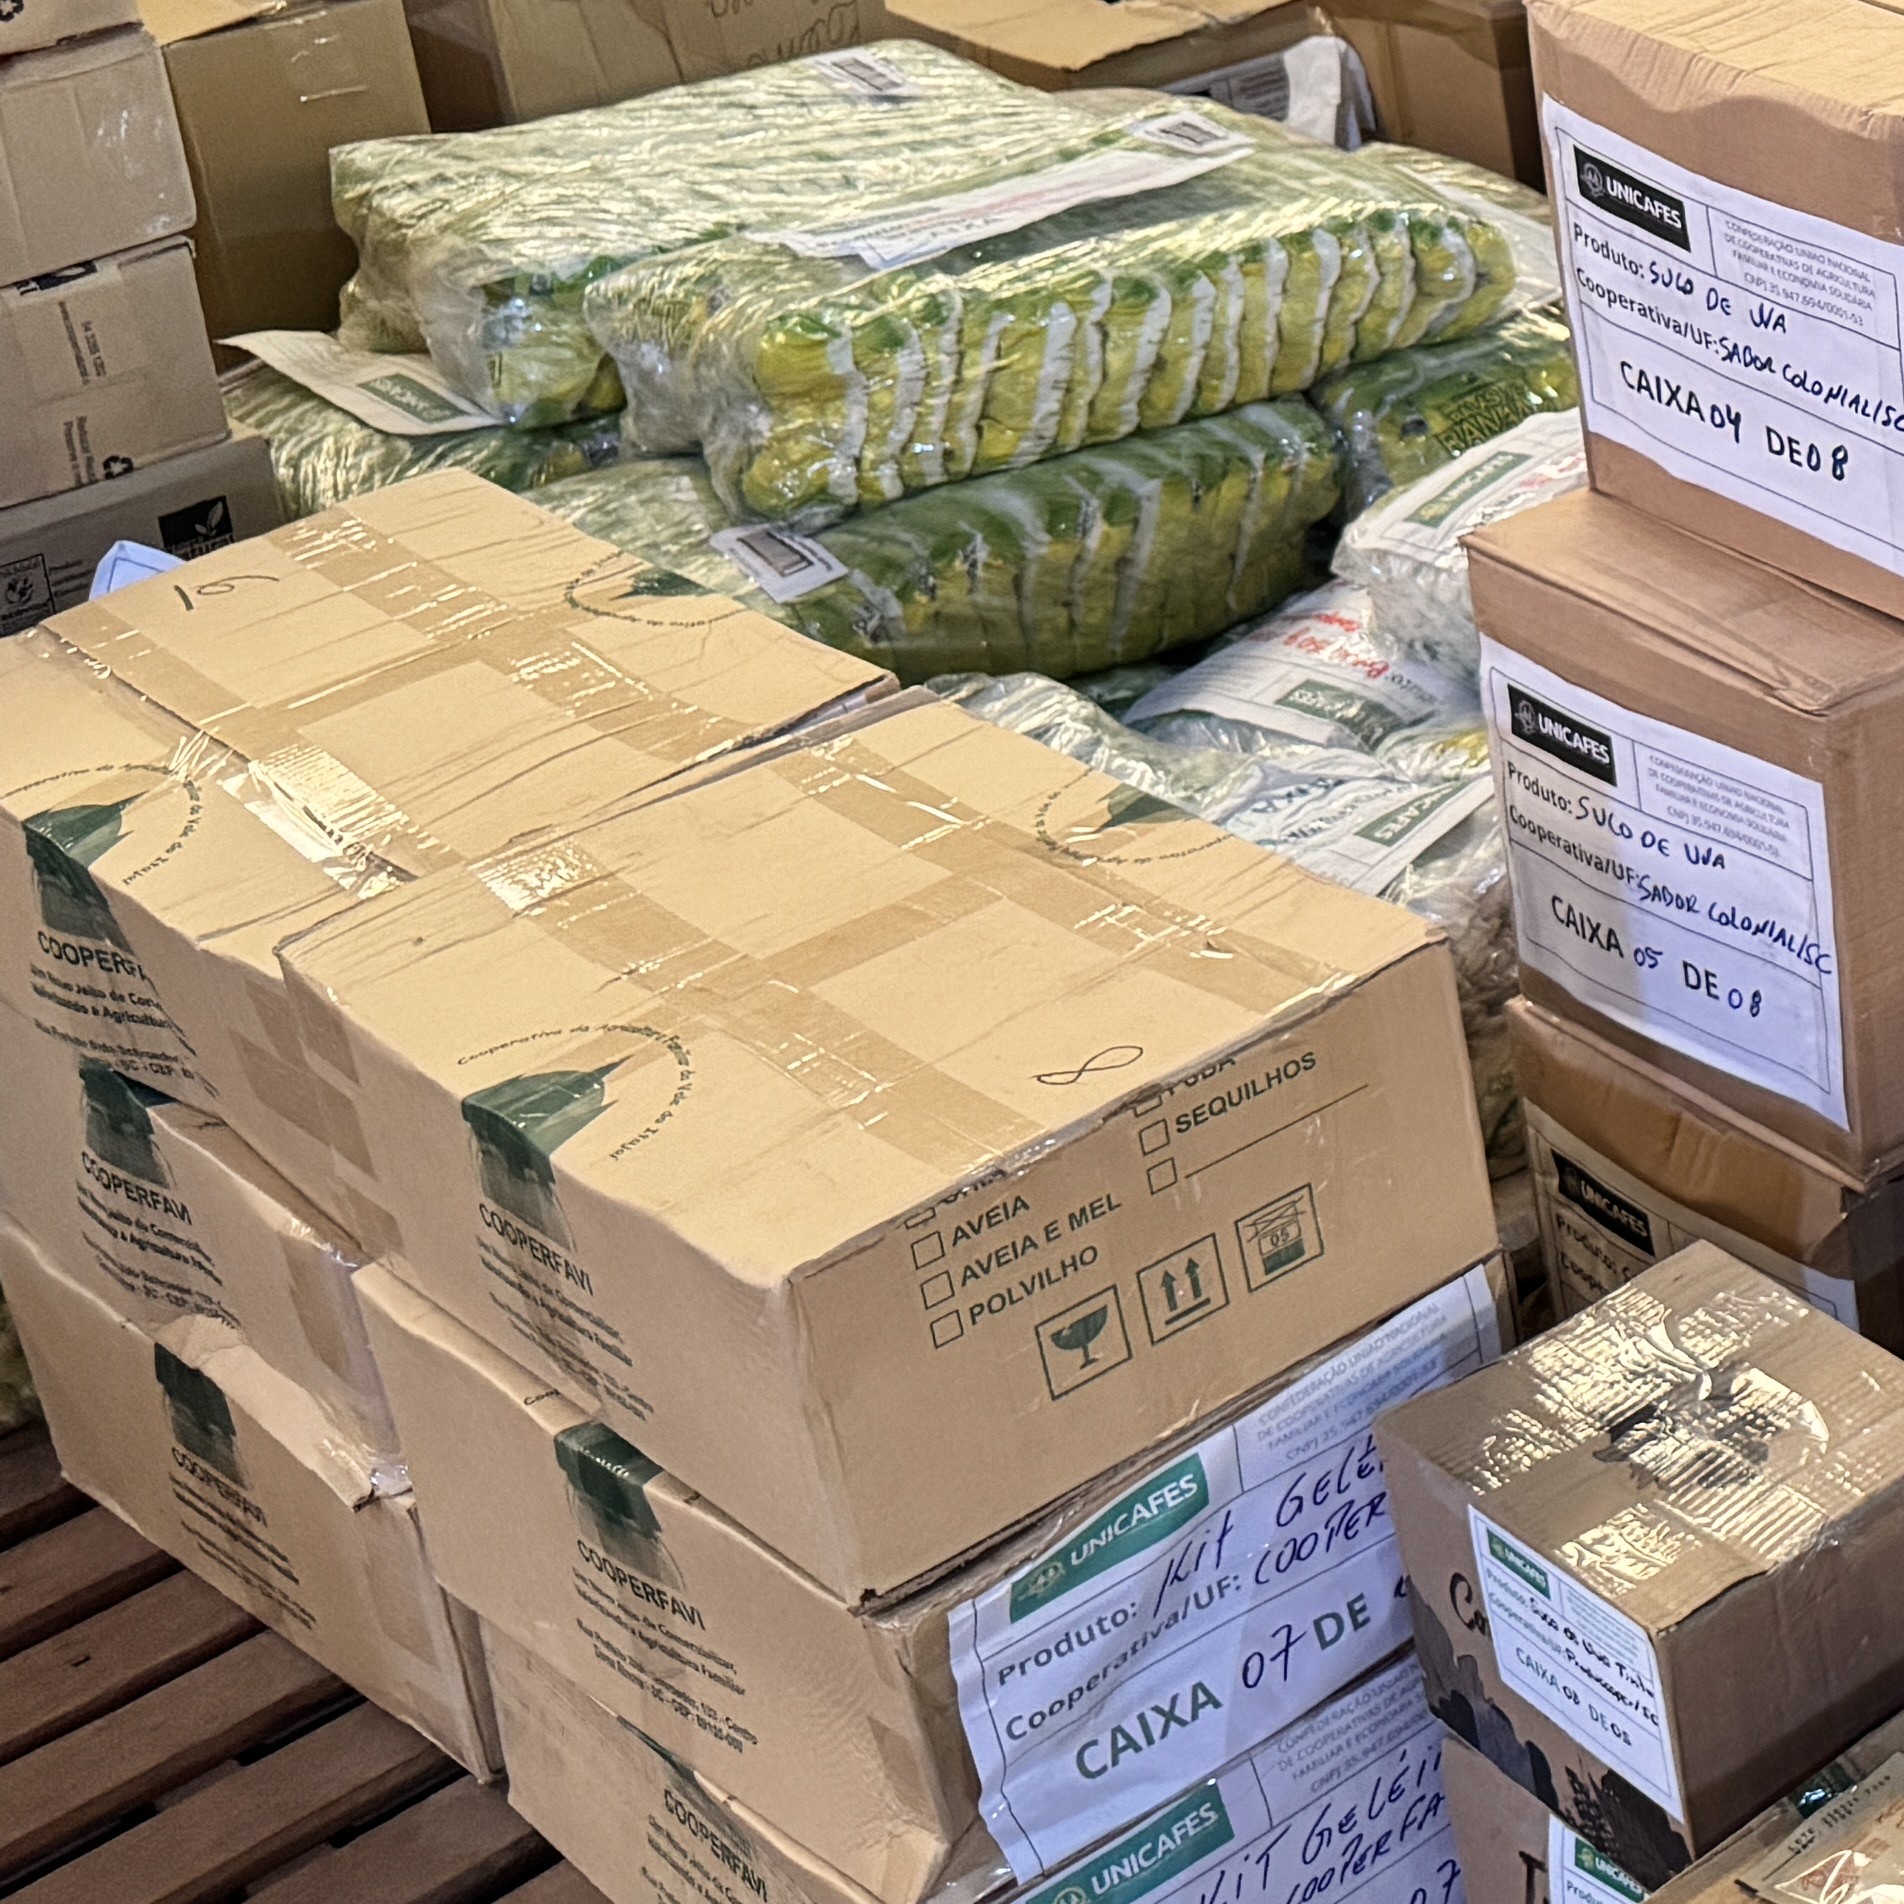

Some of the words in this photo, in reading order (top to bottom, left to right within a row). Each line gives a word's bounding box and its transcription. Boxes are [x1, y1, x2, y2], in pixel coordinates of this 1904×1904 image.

[1606, 174, 1683, 229] UNICAFES
[1573, 223, 1646, 280] Produto:
[1575, 269, 1719, 356] Cooperativa/UF:
[1619, 360, 1706, 424] CAIXA
[1708, 403, 1742, 444] 04
[1766, 425, 1802, 466] DE
[1537, 713, 1611, 766] UNICAFES
[1507, 761, 1573, 817] Produto:
[1508, 803, 1638, 888] Cooperativa/UF:
[1551, 894, 1625, 960] CAIXA
[1633, 946, 1664, 971] 05
[1681, 959, 1720, 1002] DE
[1175, 1050, 1318, 1137] SEQUILHOS
[81, 1150, 193, 1227] COOPERFAVI
[951, 1194, 1031, 1249] AVEIA
[478, 1202, 595, 1297] COOPERFAVI
[960, 1233, 1040, 1288] AVEIA
[1066, 1192, 1125, 1235] MEL
[967, 1245, 1100, 1325] POLVILHO
[1068, 1471, 1199, 1568] UNICAFES
[576, 1538, 707, 1632] COOPERFAVI
[997, 1594, 1139, 1686] Produto:
[1003, 1571, 1242, 1742] Cooperativa/UF:
[1075, 1680, 1225, 1782] CAIXA
[1240, 1613, 1308, 1692] 07
[1313, 1591, 1373, 1653] DE
[1090, 1801, 1219, 1897] UNICAFES
